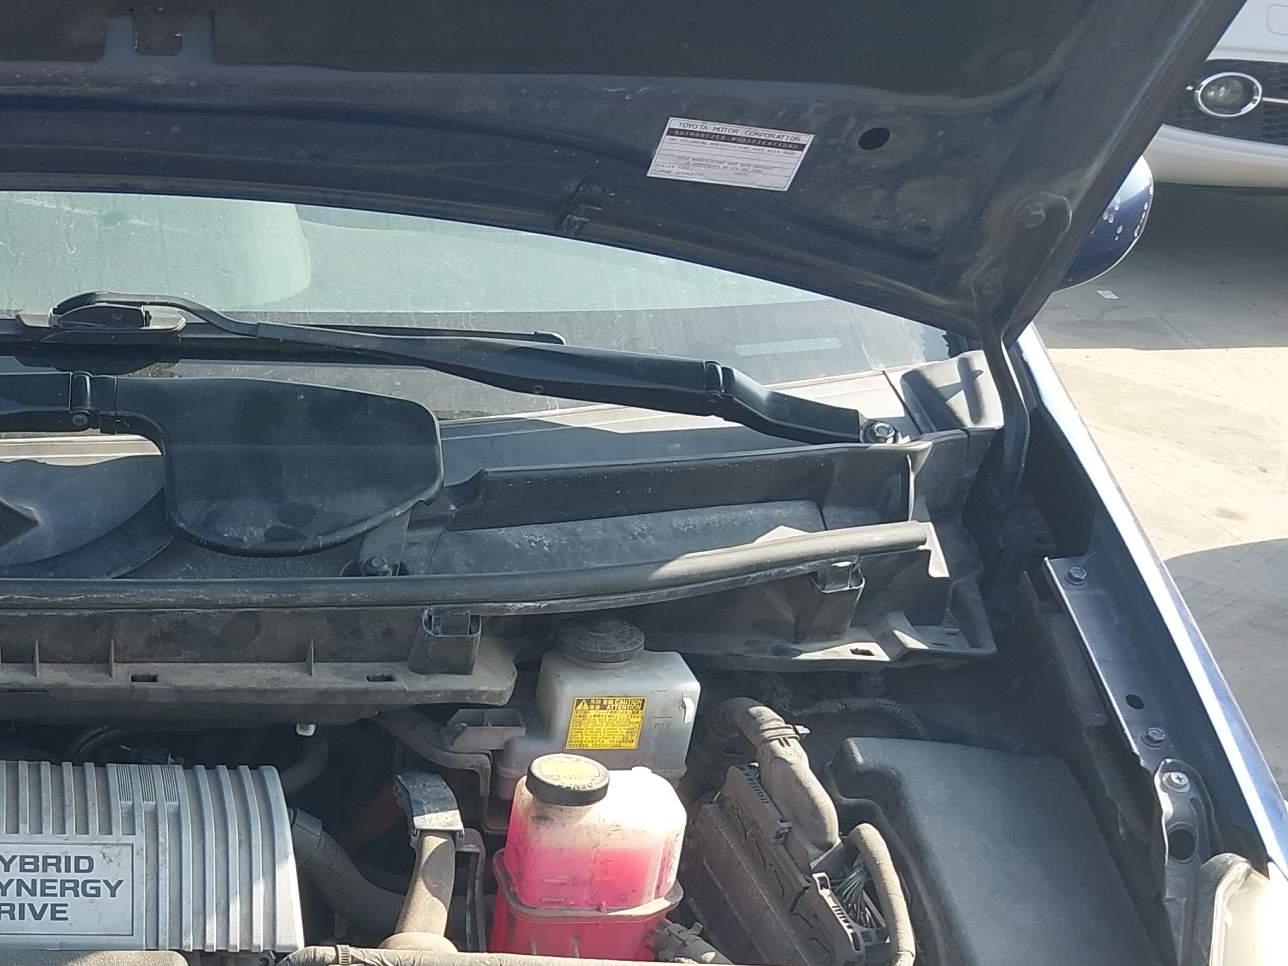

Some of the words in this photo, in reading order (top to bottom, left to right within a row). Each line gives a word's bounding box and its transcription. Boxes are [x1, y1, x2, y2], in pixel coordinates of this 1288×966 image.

[677, 121, 709, 130] TOYOTA
[711, 125, 739, 134] MOTOR
[743, 129, 801, 142] CORPORATION
